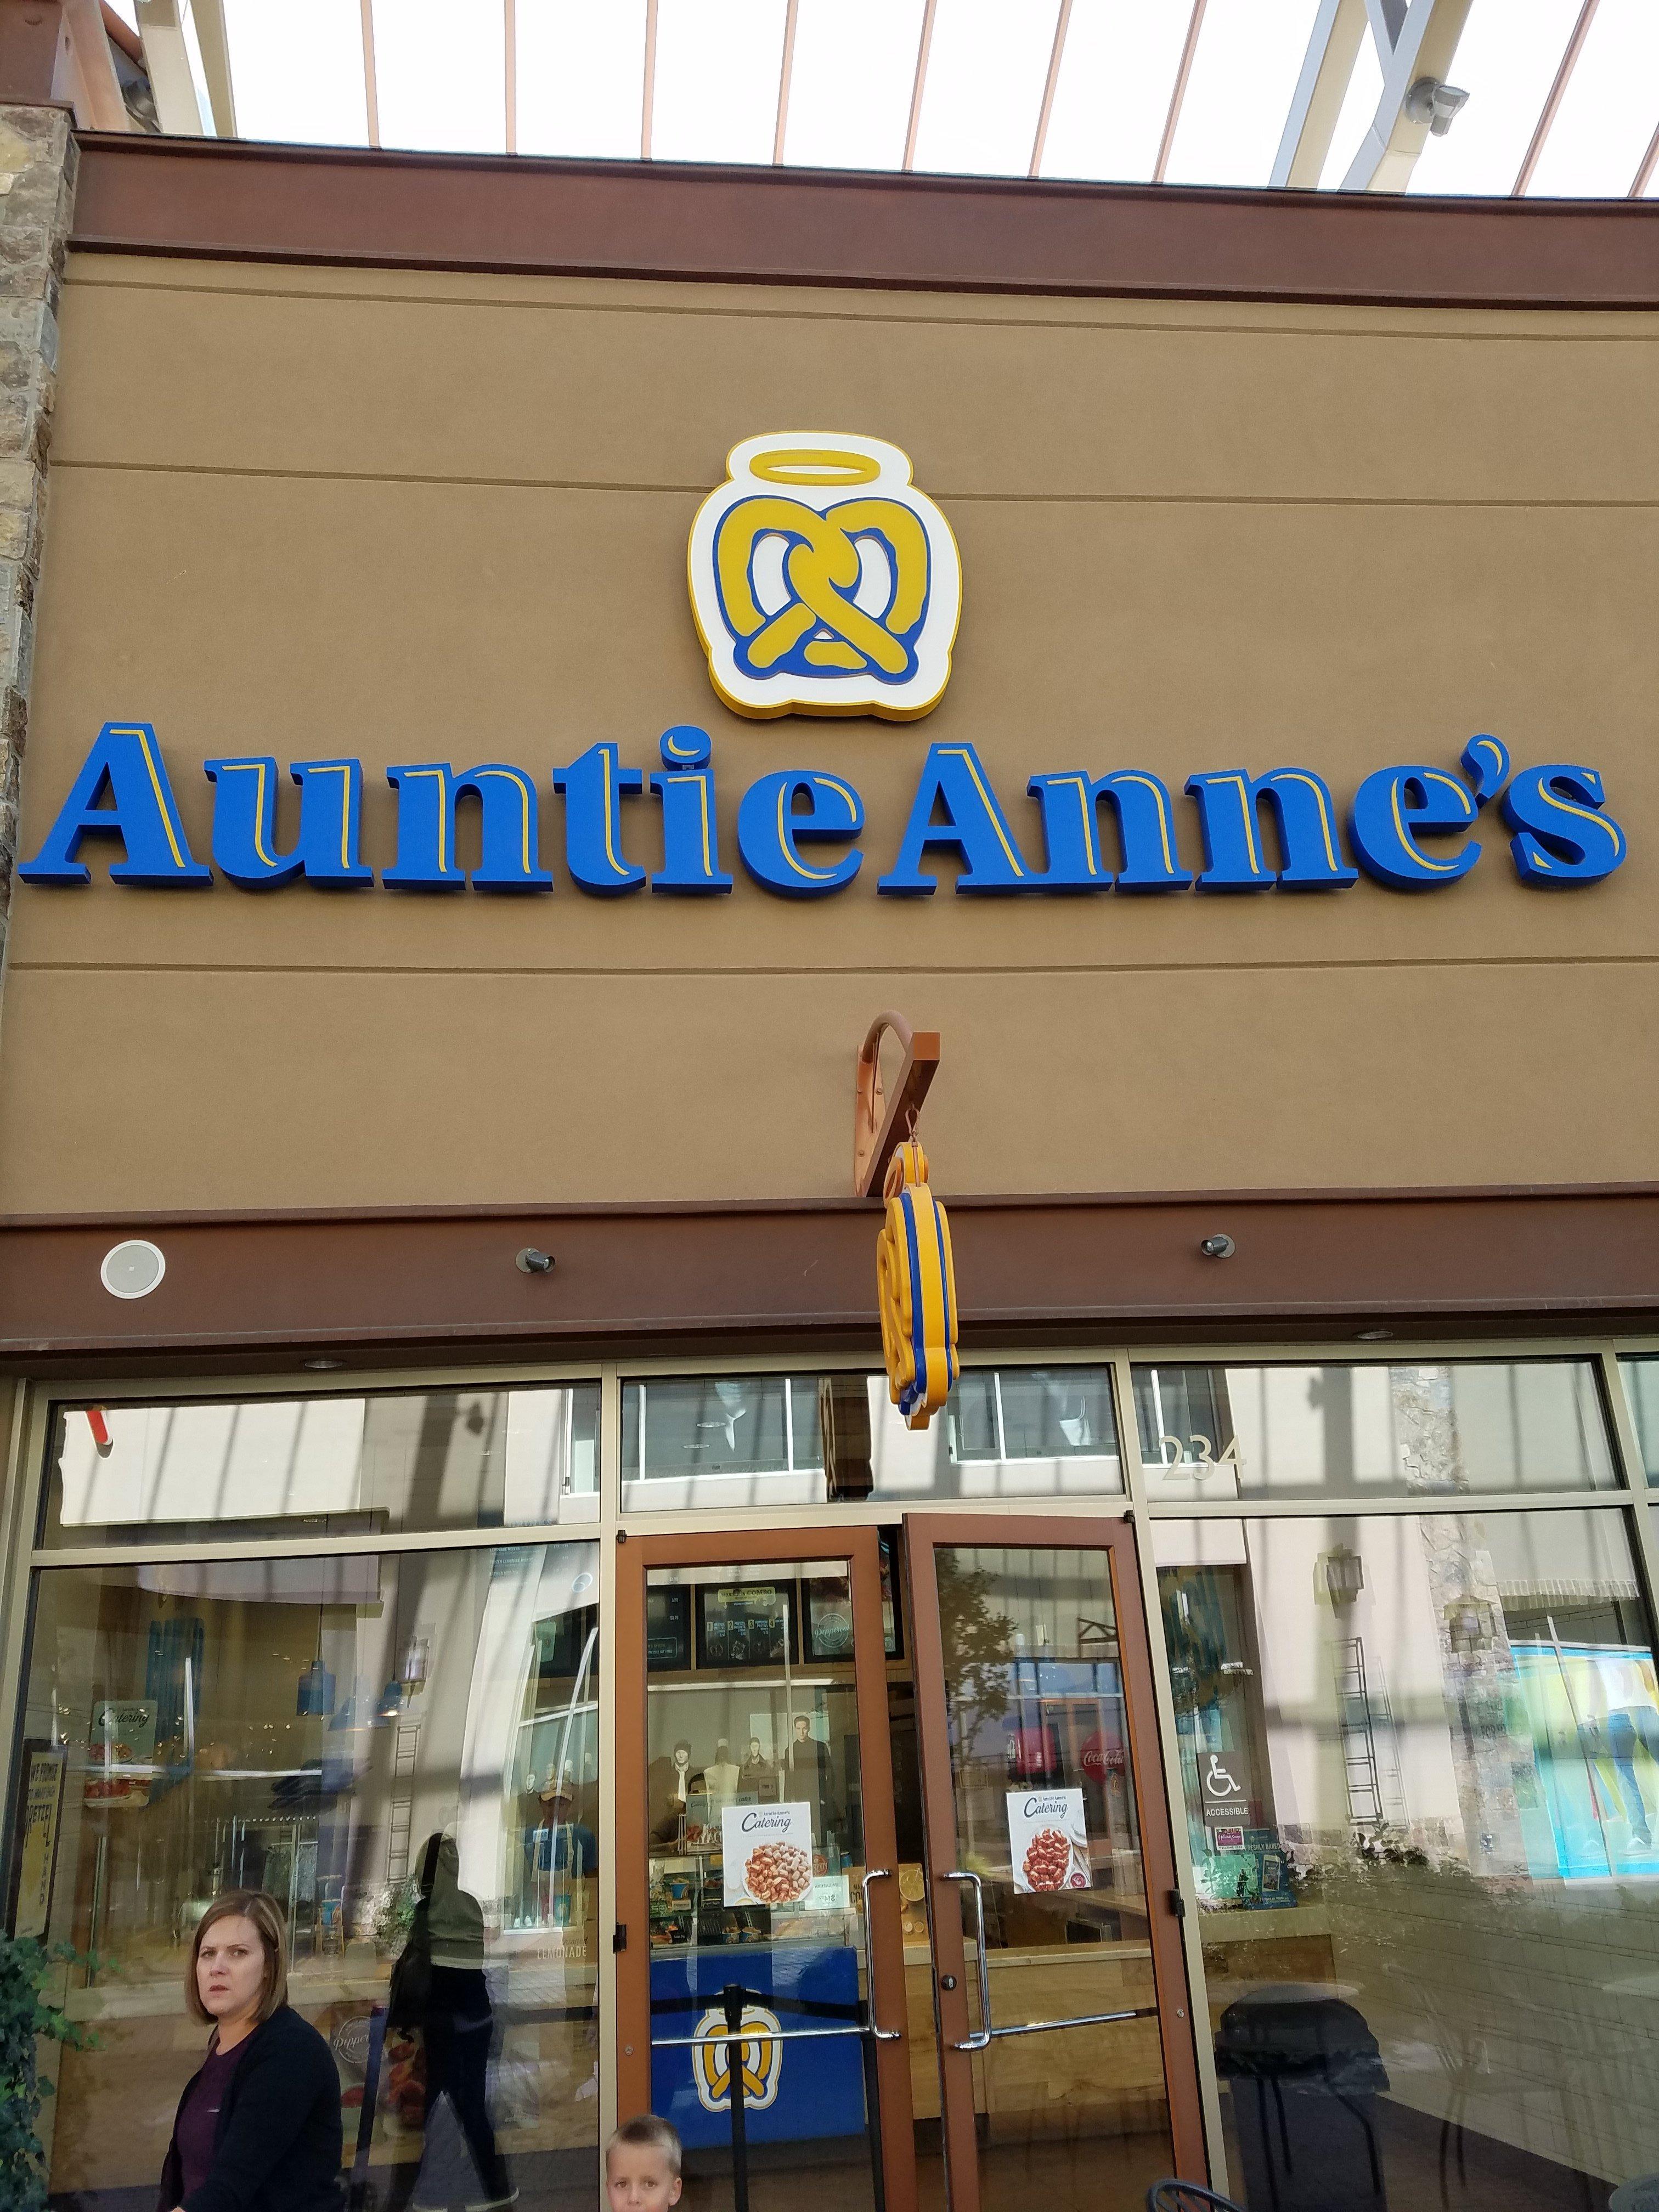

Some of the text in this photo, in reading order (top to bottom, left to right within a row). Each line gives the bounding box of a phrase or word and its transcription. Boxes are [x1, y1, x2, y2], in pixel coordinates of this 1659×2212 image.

[18, 721, 1628, 898] Auntie Anne's
[1159, 1435, 1246, 1480] 234
[99, 1707, 150, 1728] Ctering
[1024, 1797, 1068, 1819] Catering
[1206, 1807, 1249, 1816] ACCESSIBLE
[741, 1812, 792, 1833] Catering
[538, 1945, 587, 1960] LEMONADE
